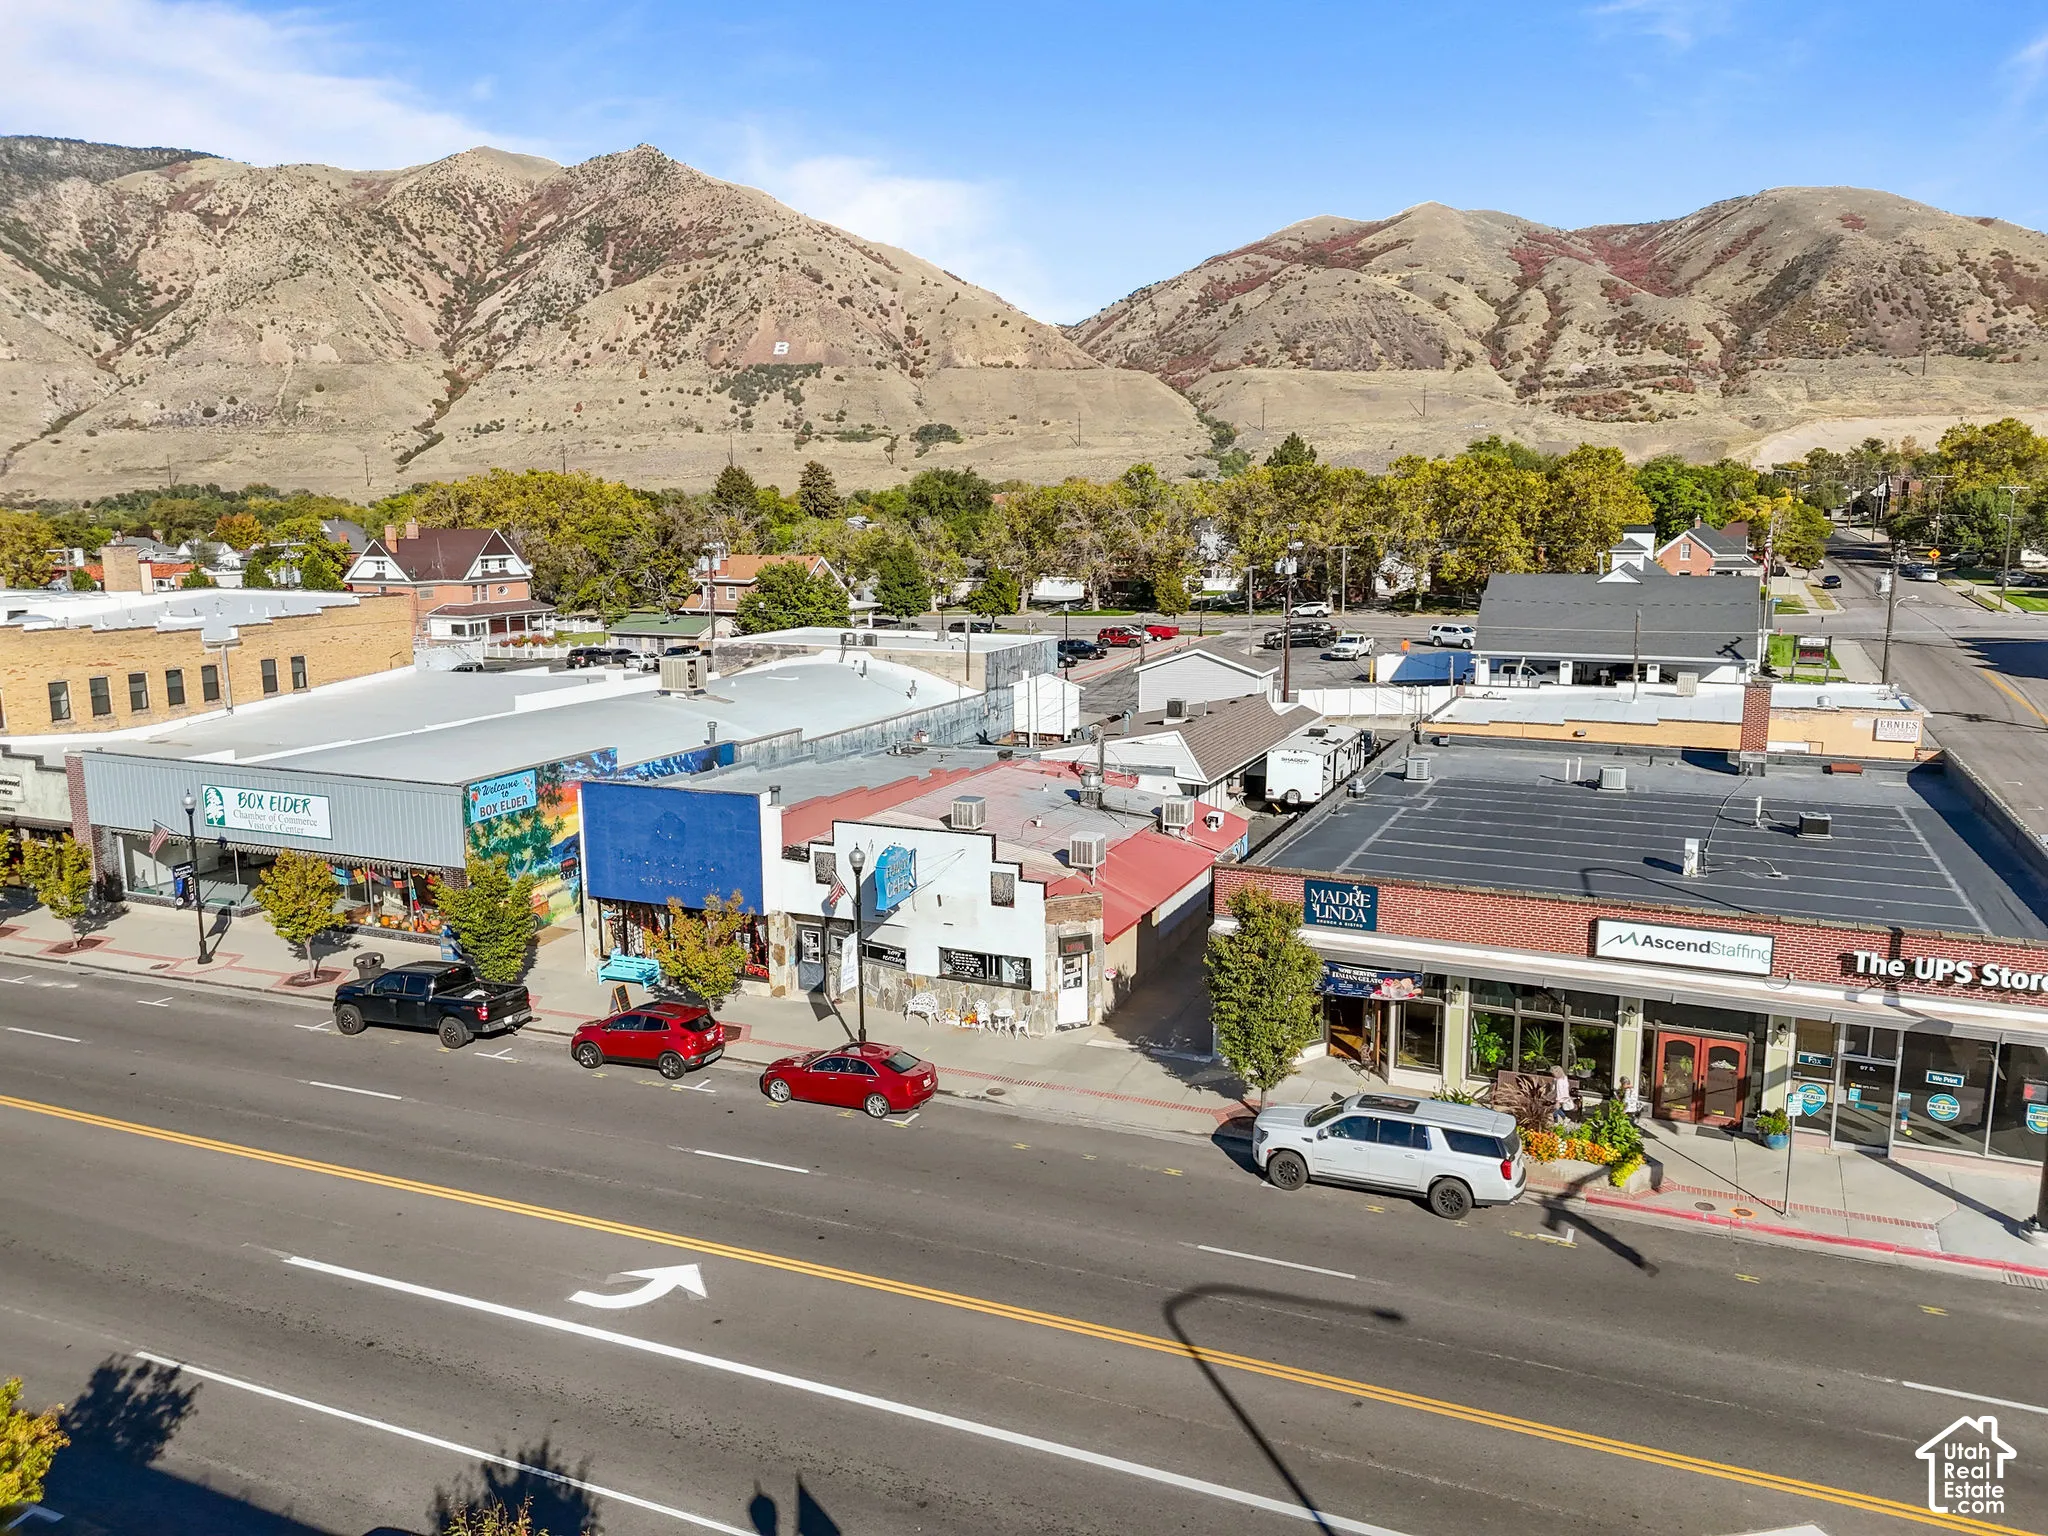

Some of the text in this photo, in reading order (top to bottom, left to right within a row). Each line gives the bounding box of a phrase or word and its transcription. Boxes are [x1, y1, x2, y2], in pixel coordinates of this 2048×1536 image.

[481, 780, 519, 796] Welcome
[237, 791, 311, 816] BOX ELDER
[480, 795, 528, 817] BOX ELDER
[233, 809, 317, 827] Chamber of Commerce
[248, 820, 304, 834] Visitor's Center
[887, 873, 909, 898] CAFE
[1310, 888, 1371, 908] MADRE
[1315, 904, 1367, 922] LINDA
[1338, 967, 1377, 978] NOW SERVING
[1853, 950, 1906, 977] The
[1914, 956, 1973, 984] UPS
[1332, 971, 1383, 984] ITALIAN GELATO
[1808, 1056, 1822, 1065] Fax
[1943, 1076, 1958, 1084] Print
